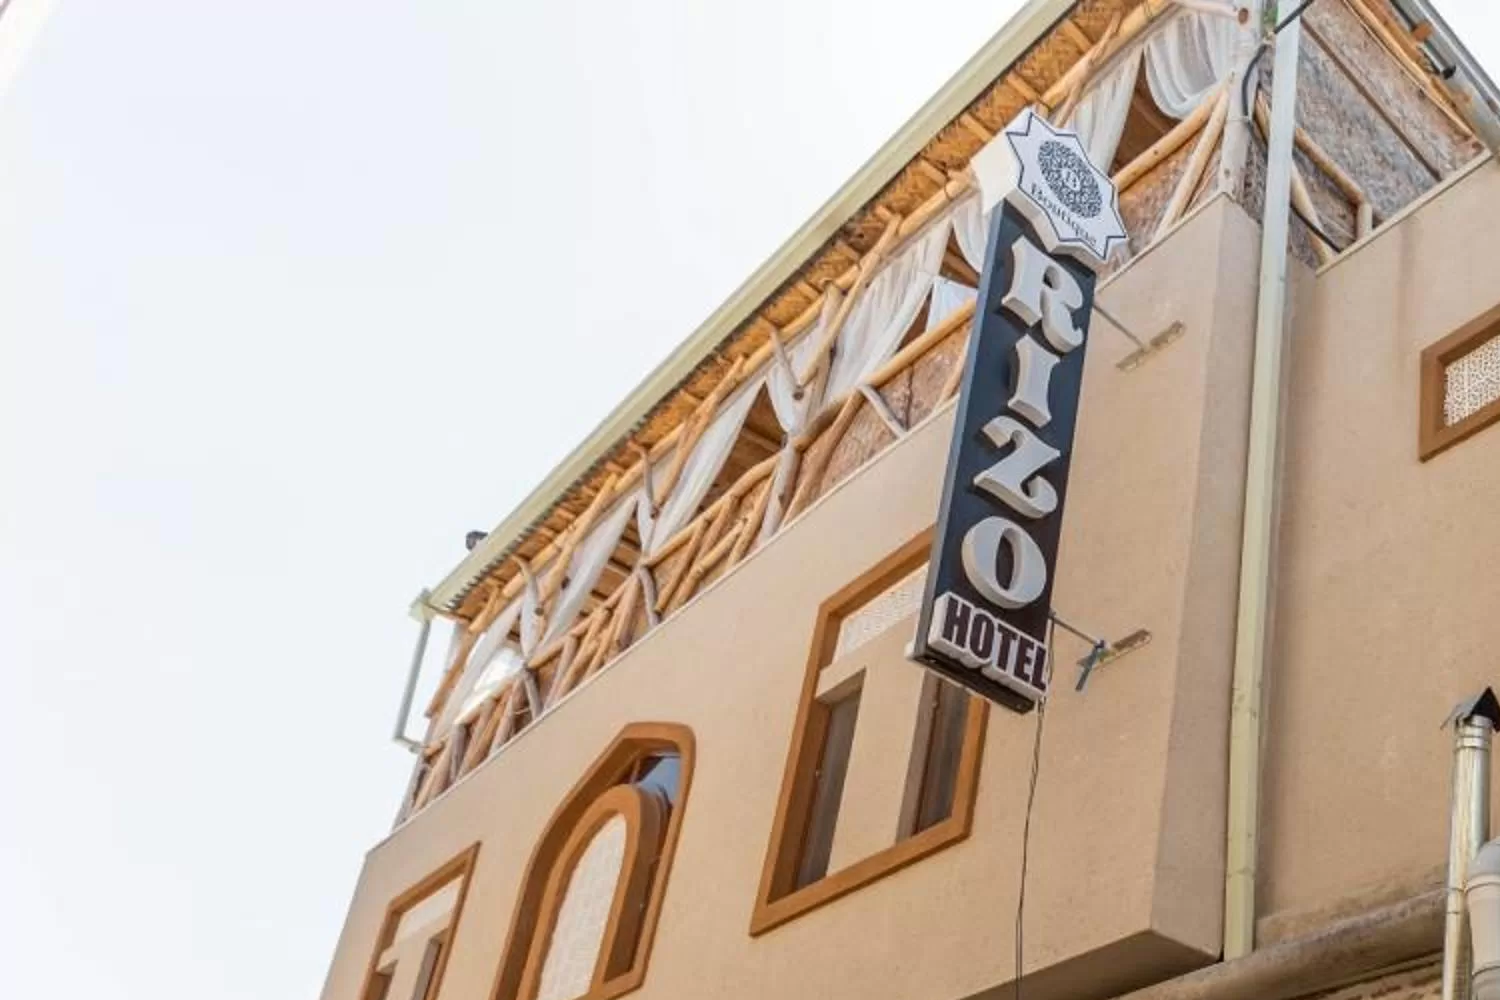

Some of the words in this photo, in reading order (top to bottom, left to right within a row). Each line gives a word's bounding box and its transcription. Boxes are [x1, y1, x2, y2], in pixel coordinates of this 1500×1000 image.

[1030, 183, 1097, 246] Boutique
[961, 235, 1085, 610] RIZO
[942, 596, 1047, 691] HOTEL
